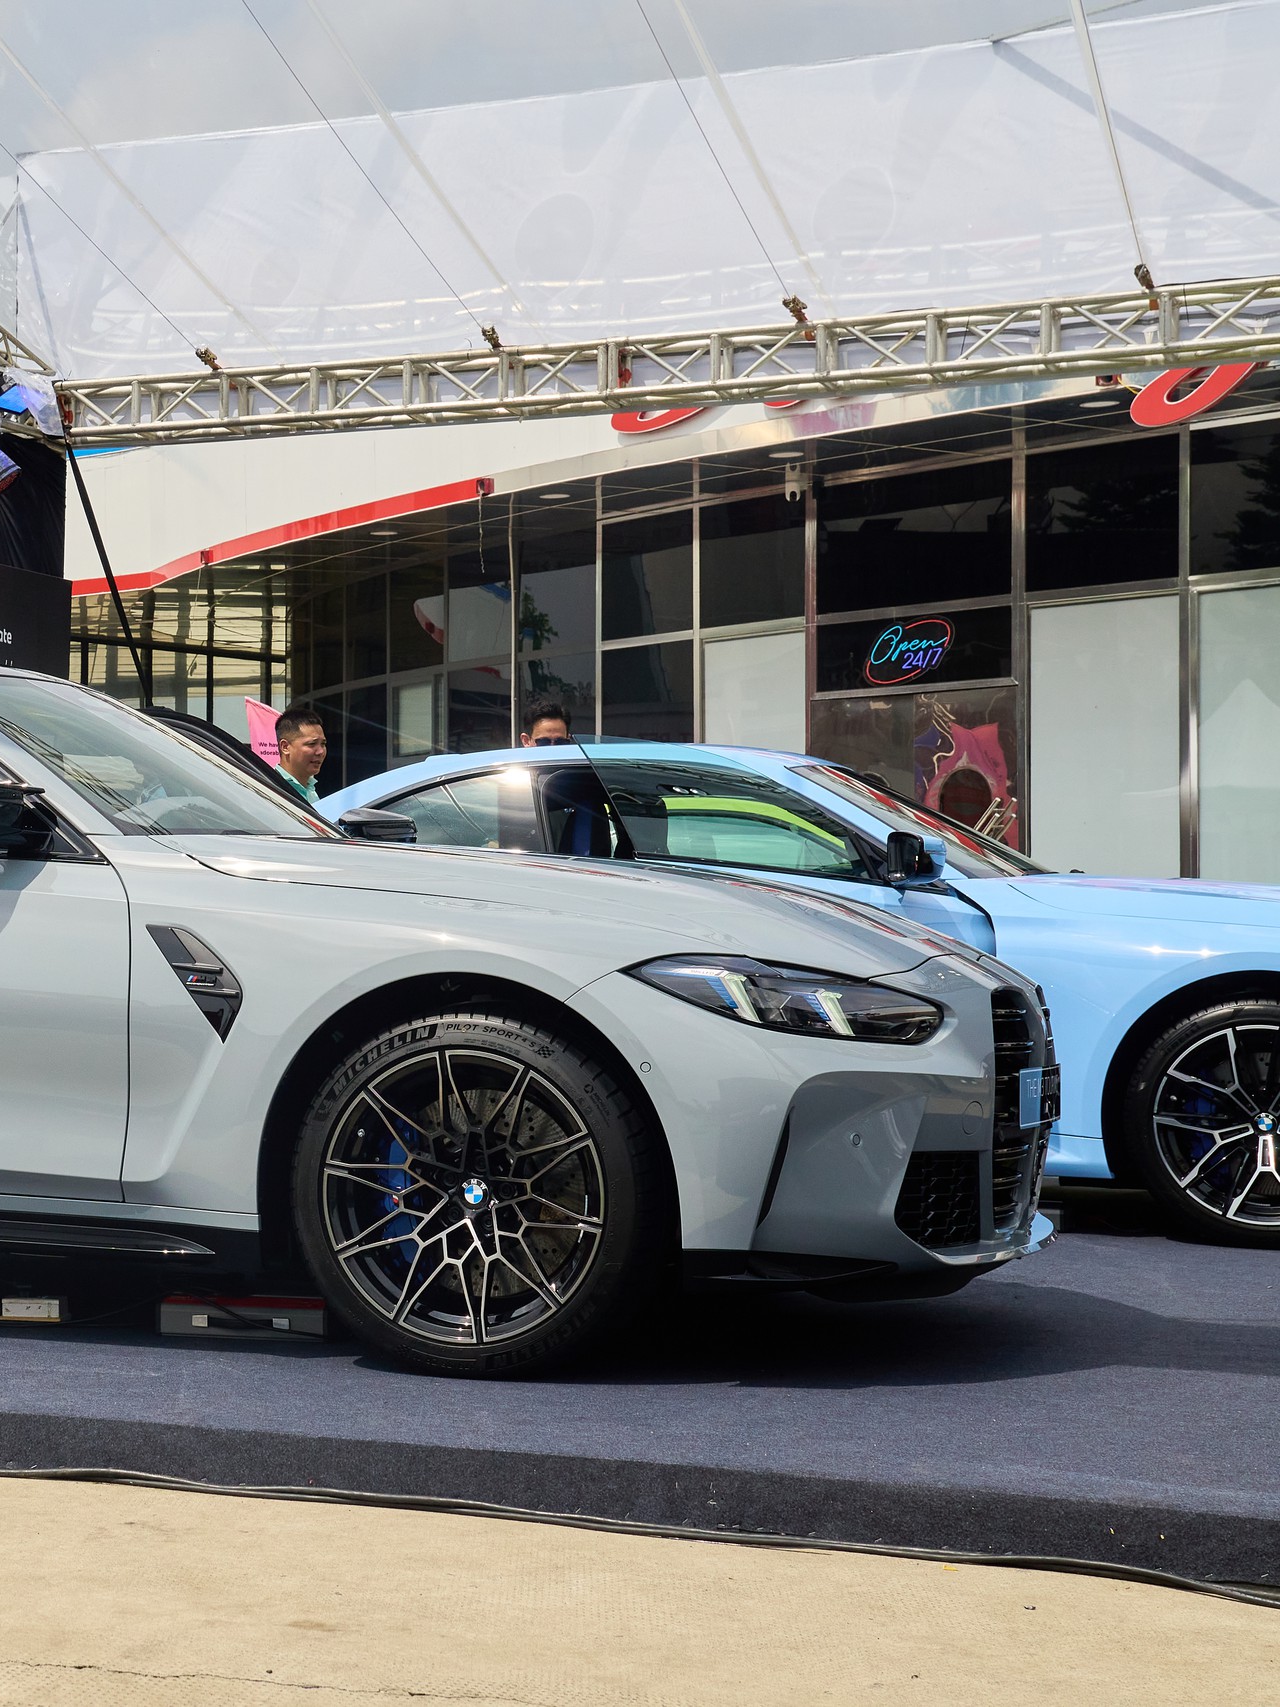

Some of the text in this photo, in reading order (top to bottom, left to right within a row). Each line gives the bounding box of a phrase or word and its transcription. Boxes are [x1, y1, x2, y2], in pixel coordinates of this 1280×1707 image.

[870, 625, 948, 665] Open
[901, 647, 943, 669] 24/7
[445, 1023, 479, 1032] PILOT
[482, 1025, 522, 1041] SPORT
[333, 1025, 431, 1096] MICHELIN
